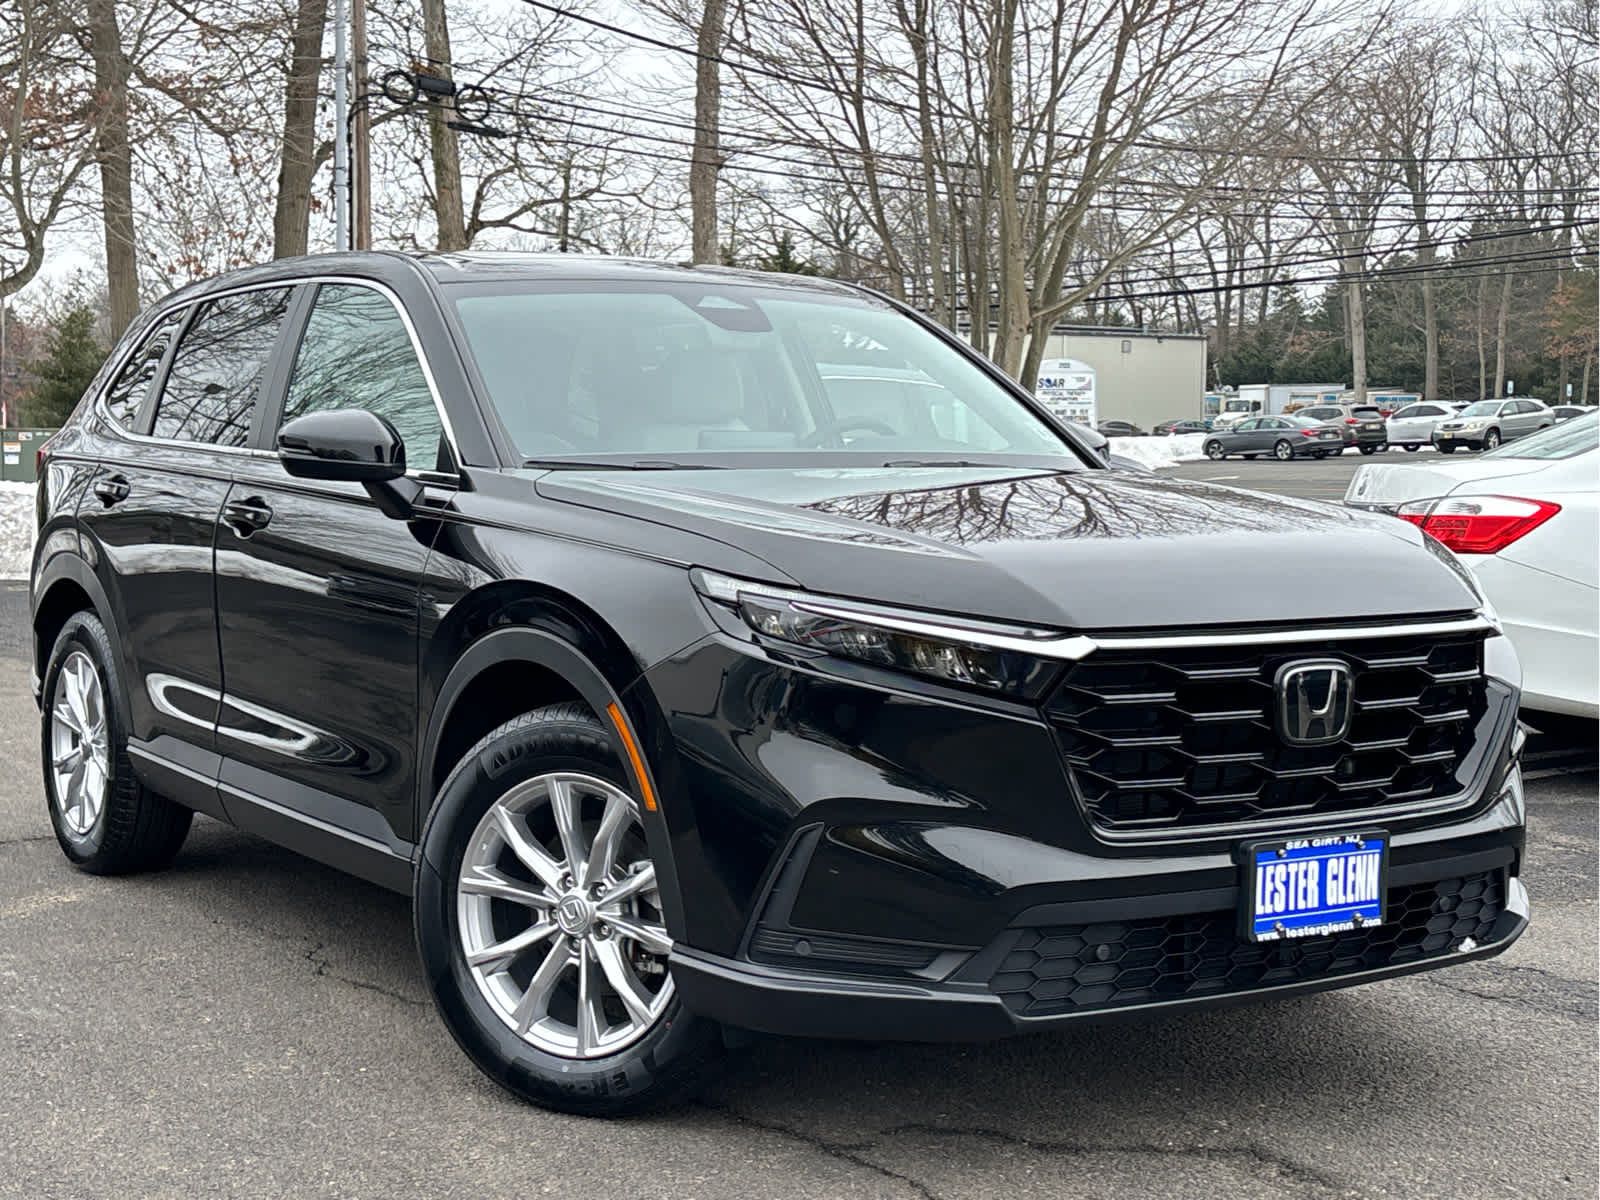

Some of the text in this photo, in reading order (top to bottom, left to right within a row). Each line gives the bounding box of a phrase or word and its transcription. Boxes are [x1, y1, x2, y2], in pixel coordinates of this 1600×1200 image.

[1038, 378, 1065, 388] SOAR
[1286, 840, 1310, 850] SEA
[1255, 853, 1380, 915] LESTER GLENN
